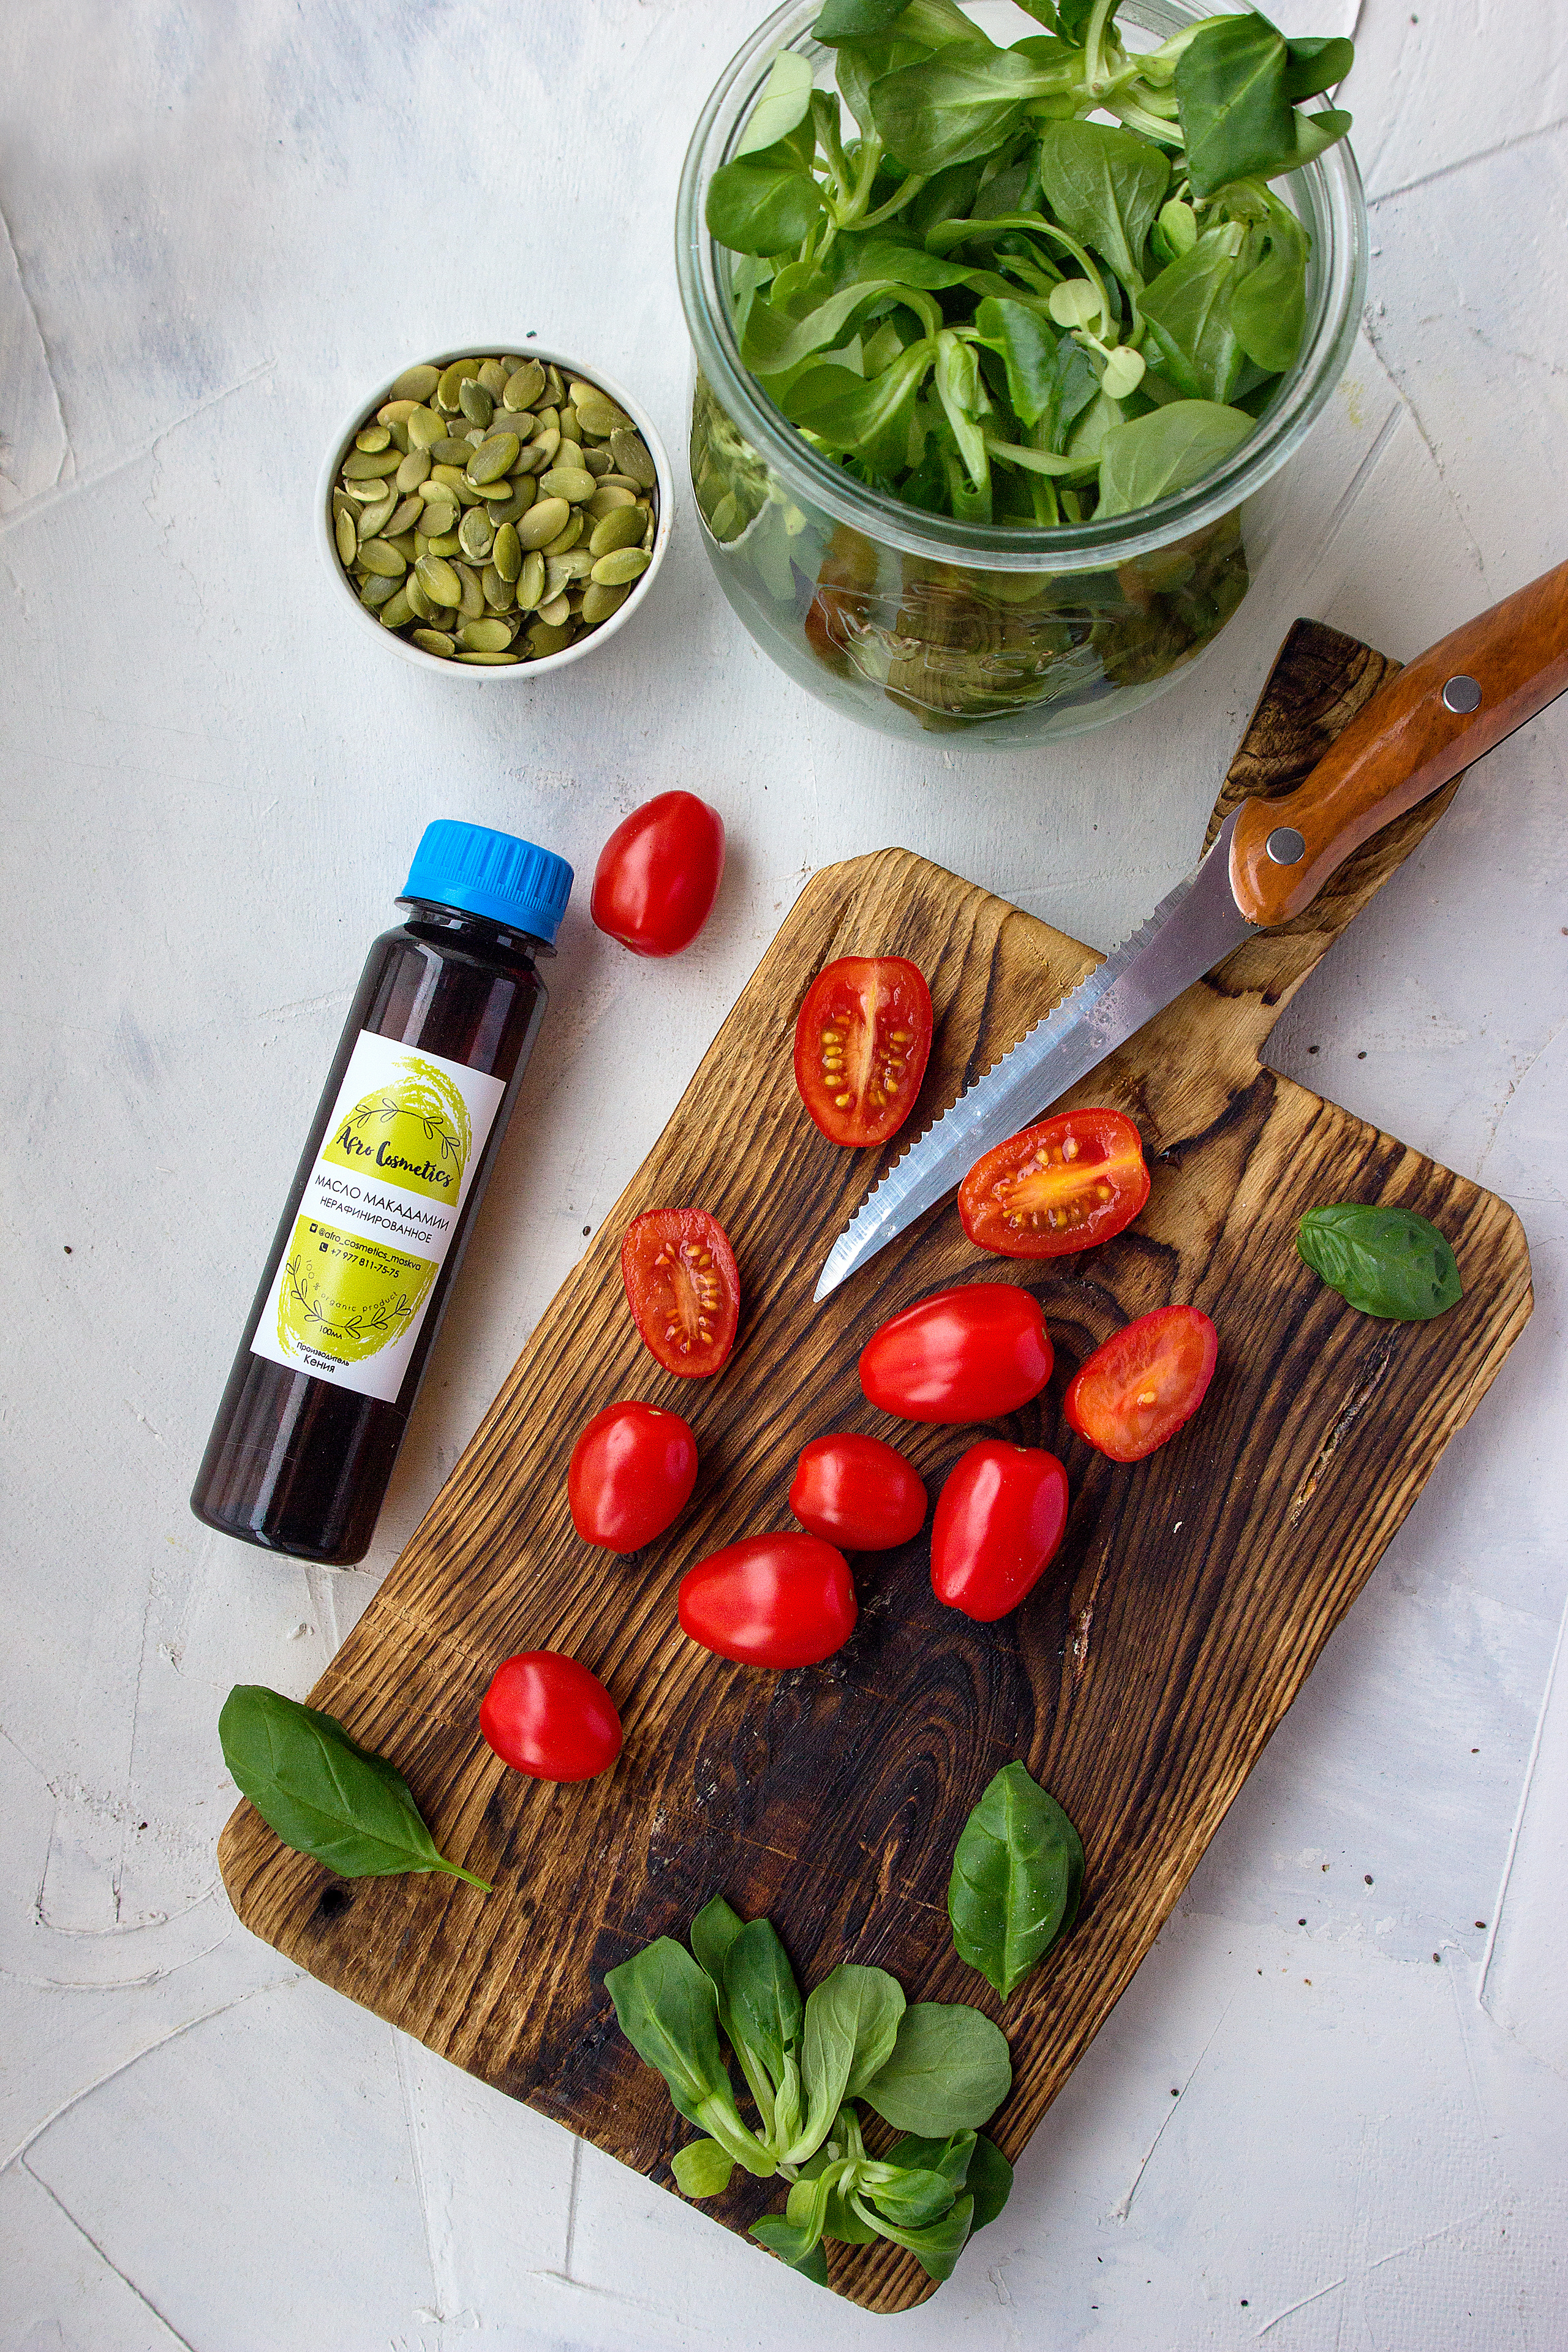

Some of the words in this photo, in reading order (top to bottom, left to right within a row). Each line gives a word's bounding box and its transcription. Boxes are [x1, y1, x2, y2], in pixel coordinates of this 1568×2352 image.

[336, 1126, 374, 1155] Afro
[375, 1140, 454, 1188] Cosmetics
[315, 1174, 361, 1199] МАСЛО
[363, 1192, 450, 1231] МАКАДАМИИ
[320, 1196, 432, 1243] НЕРАФИНИРОВАННОЕ
[318, 1227, 421, 1271] @afro_cosmetics_moskva
[331, 1248, 341, 1257] +7
[343, 1252, 358, 1263] 977
[359, 1258, 400, 1278] 811-75-75
[321, 1293, 356, 1312] organic
[363, 1291, 398, 1313] product
[320, 1325, 342, 1340] 100мл
[297, 1341, 350, 1366] Производитель
[303, 1354, 335, 1373] Кения
